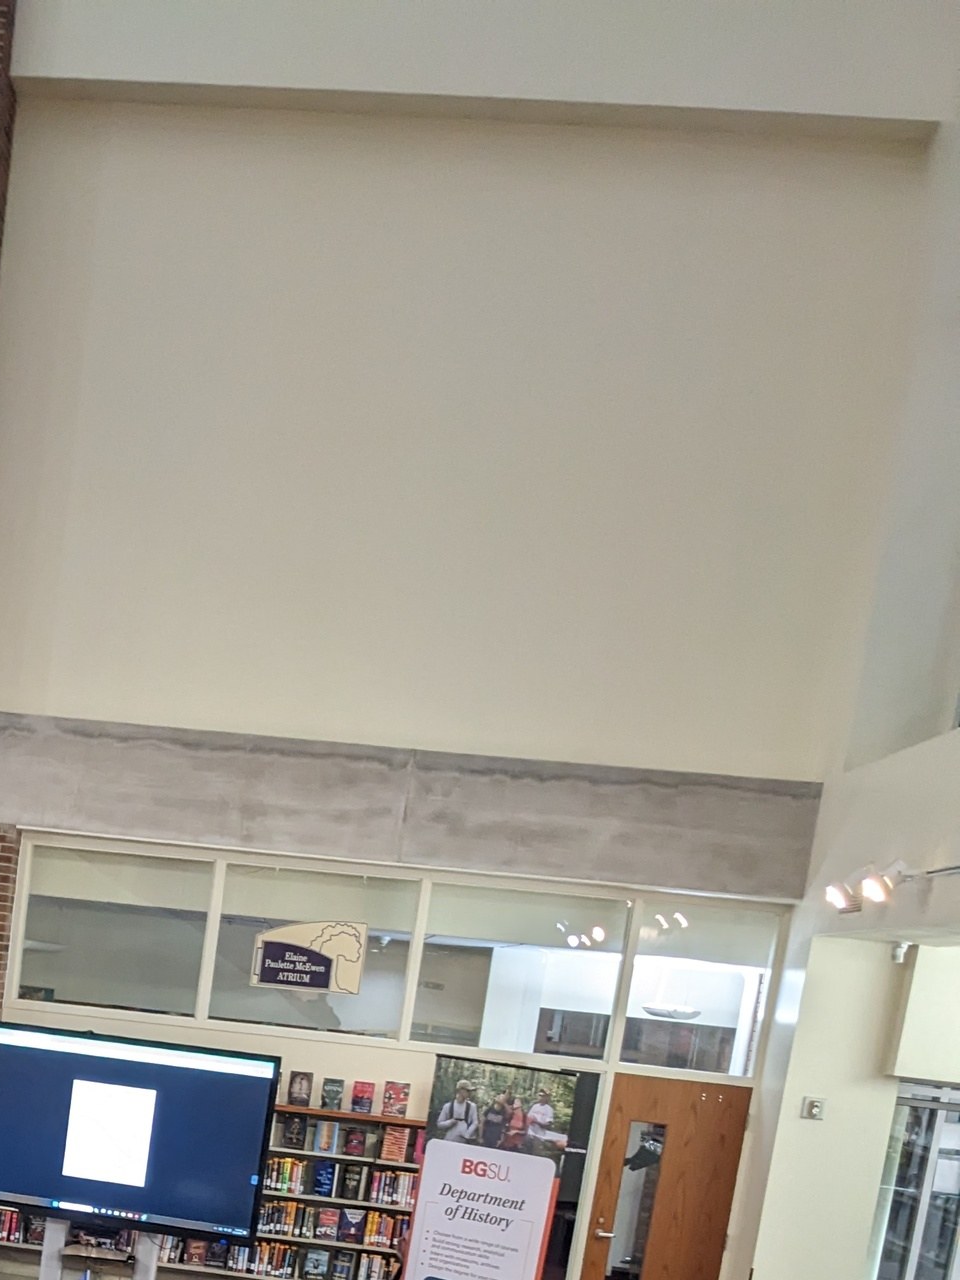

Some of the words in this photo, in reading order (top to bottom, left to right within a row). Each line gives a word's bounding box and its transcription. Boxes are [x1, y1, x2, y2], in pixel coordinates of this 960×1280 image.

[285, 952, 308, 962] Elaine
[265, 958, 294, 970] Paulette
[295, 962, 325, 972] McEwen
[277, 972, 310, 983] ATRIUM
[438, 1182, 526, 1211] Department
[444, 1204, 463, 1221] of
[460, 1206, 514, 1232] History
